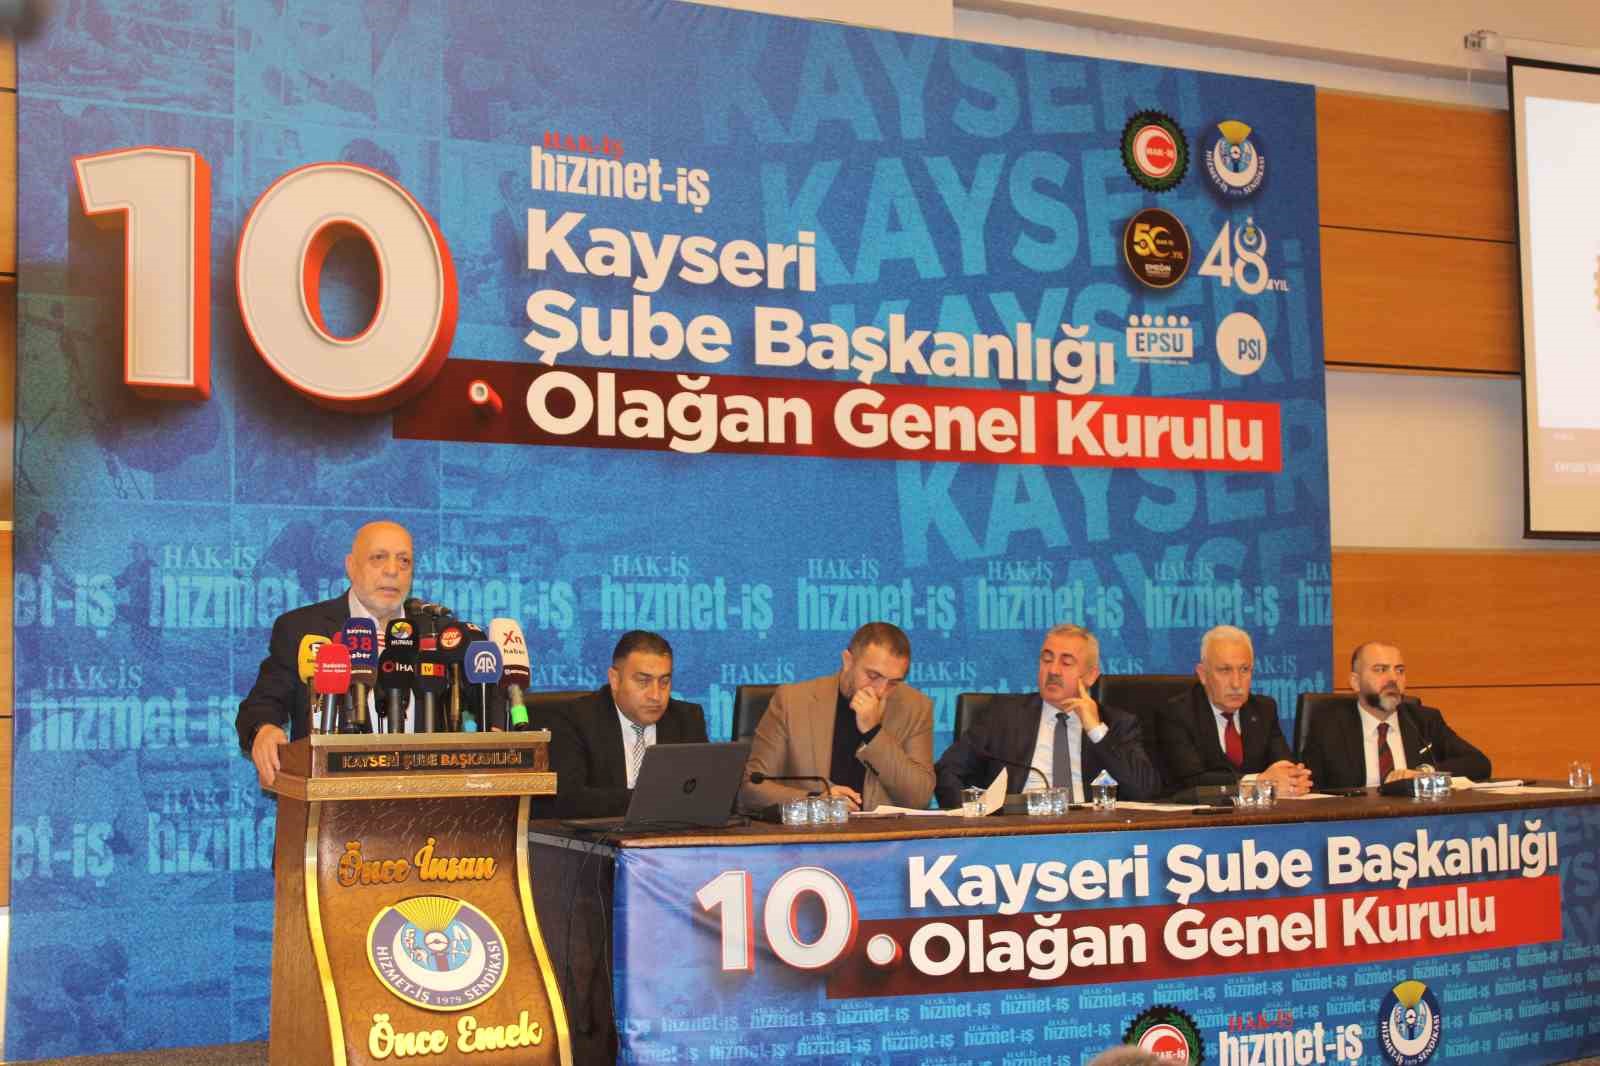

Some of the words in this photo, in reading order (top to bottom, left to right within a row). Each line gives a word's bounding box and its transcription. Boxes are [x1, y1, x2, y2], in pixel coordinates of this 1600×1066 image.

[531, 145, 710, 214] hizmet-iş
[527, 208, 816, 292] Kayseri
[1198, 216, 1268, 295] 48
[72, 146, 502, 414] 10.
[524, 289, 732, 366] Şube
[755, 305, 1115, 395] Başkanlığı
[1136, 332, 1184, 353] EPSU
[1238, 338, 1261, 361] PSI
[526, 371, 813, 453] Olağan
[834, 388, 1037, 456] Genel
[1057, 400, 1264, 462] Kurulu
[415, 549, 482, 579] AK-İŞ
[612, 555, 690, 581] HAK-İŞ
[808, 554, 880, 580] HAK-İŞ
[601, 576, 774, 640] hizmet-iş
[798, 576, 957, 639] hizmet-iş
[977, 576, 1125, 637] hizmet-iş
[1144, 578, 1280, 636] hizmet-iş
[395, 661, 414, 673] İHA
[474, 655, 497, 673] AA
[720, 656, 795, 684] HAK-İŞ
[1254, 650, 1297, 674] AK-İŞ
[337, 841, 411, 887] Önce
[414, 837, 498, 883] İnsan
[908, 845, 1149, 915] Kayseri
[1166, 839, 1313, 905] Şube
[1327, 819, 1557, 889] Başkanlığı
[695, 866, 903, 974] 10.
[909, 913, 1147, 981] Olağan
[1163, 898, 1328, 961] Genel
[1342, 886, 1496, 947] Kurulu
[376, 945, 432, 1004] HİZMET-İŞ
[435, 995, 463, 1005] 1979
[463, 940, 501, 1001] SENDİKASI
[368, 1013, 449, 1061] Önce
[456, 1011, 544, 1054] Emek
[1219, 1022, 1363, 1066] hizmet-iş
